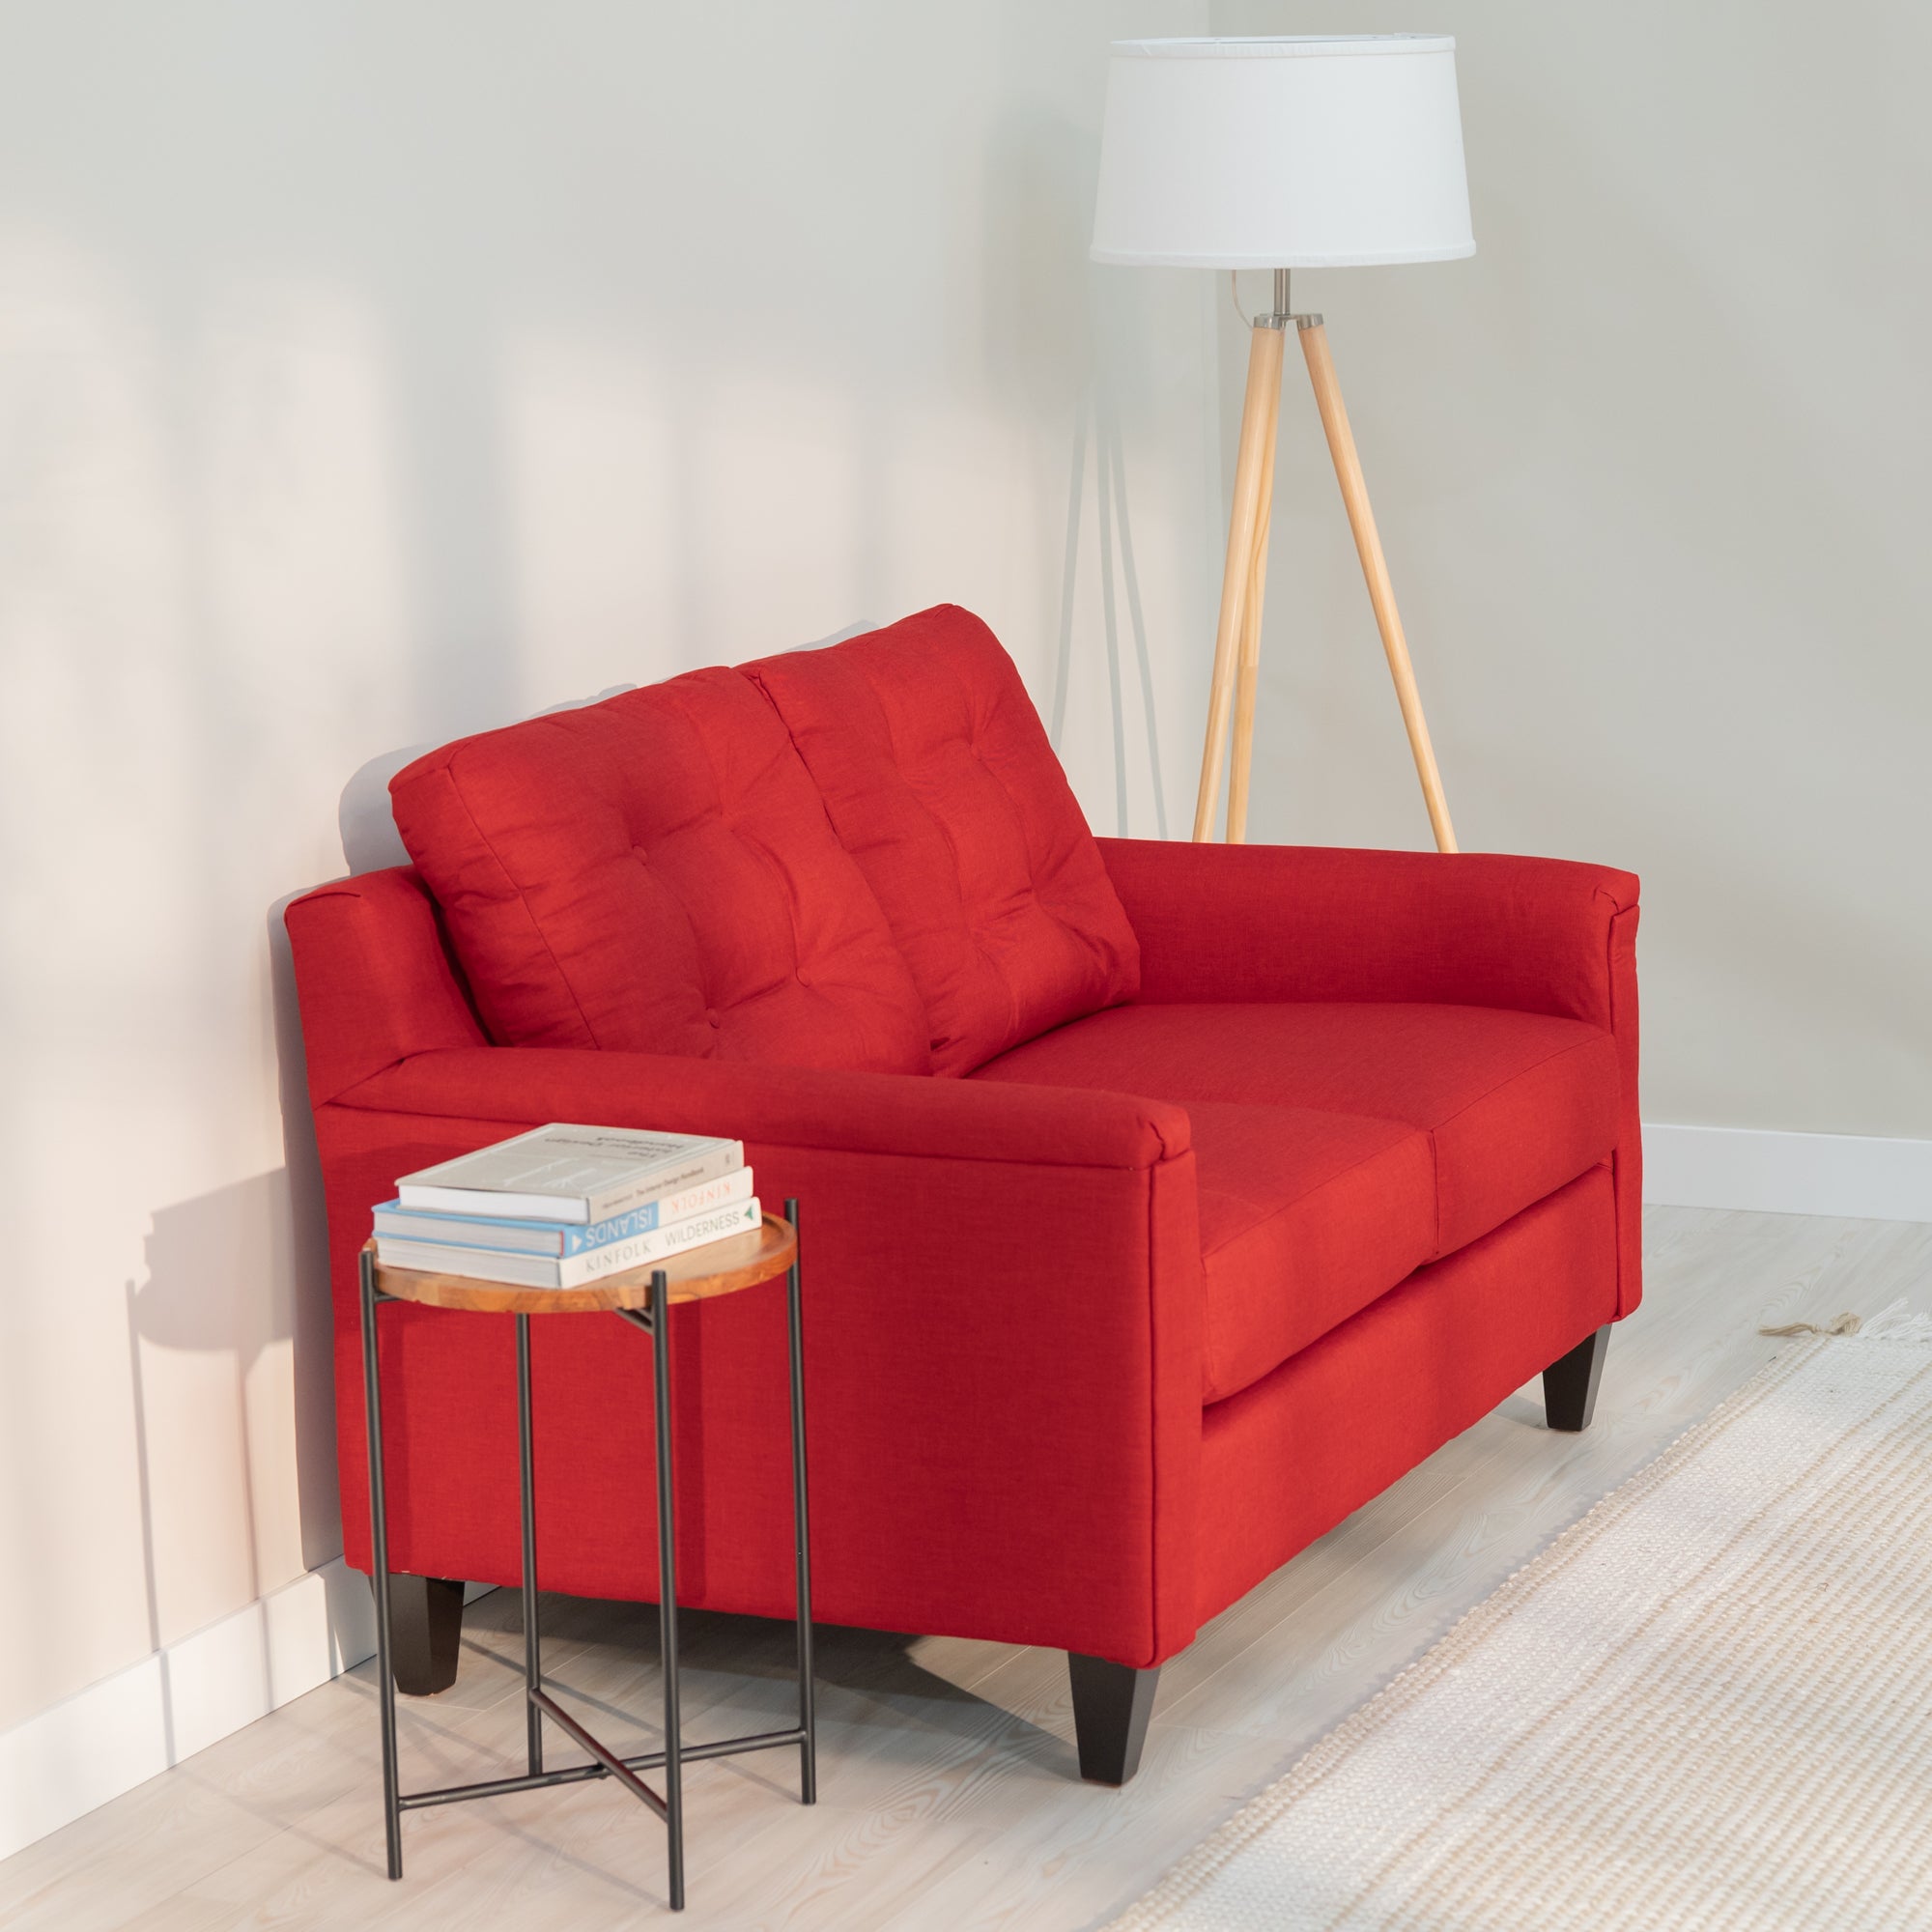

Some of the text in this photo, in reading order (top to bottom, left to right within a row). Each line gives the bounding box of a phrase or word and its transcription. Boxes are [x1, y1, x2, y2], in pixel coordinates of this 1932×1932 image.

[671, 1182, 731, 1214] KINFOLK
[584, 1207, 652, 1248] ISLANDS
[584, 1210, 741, 1273] KINFOLK WILDERNESS
